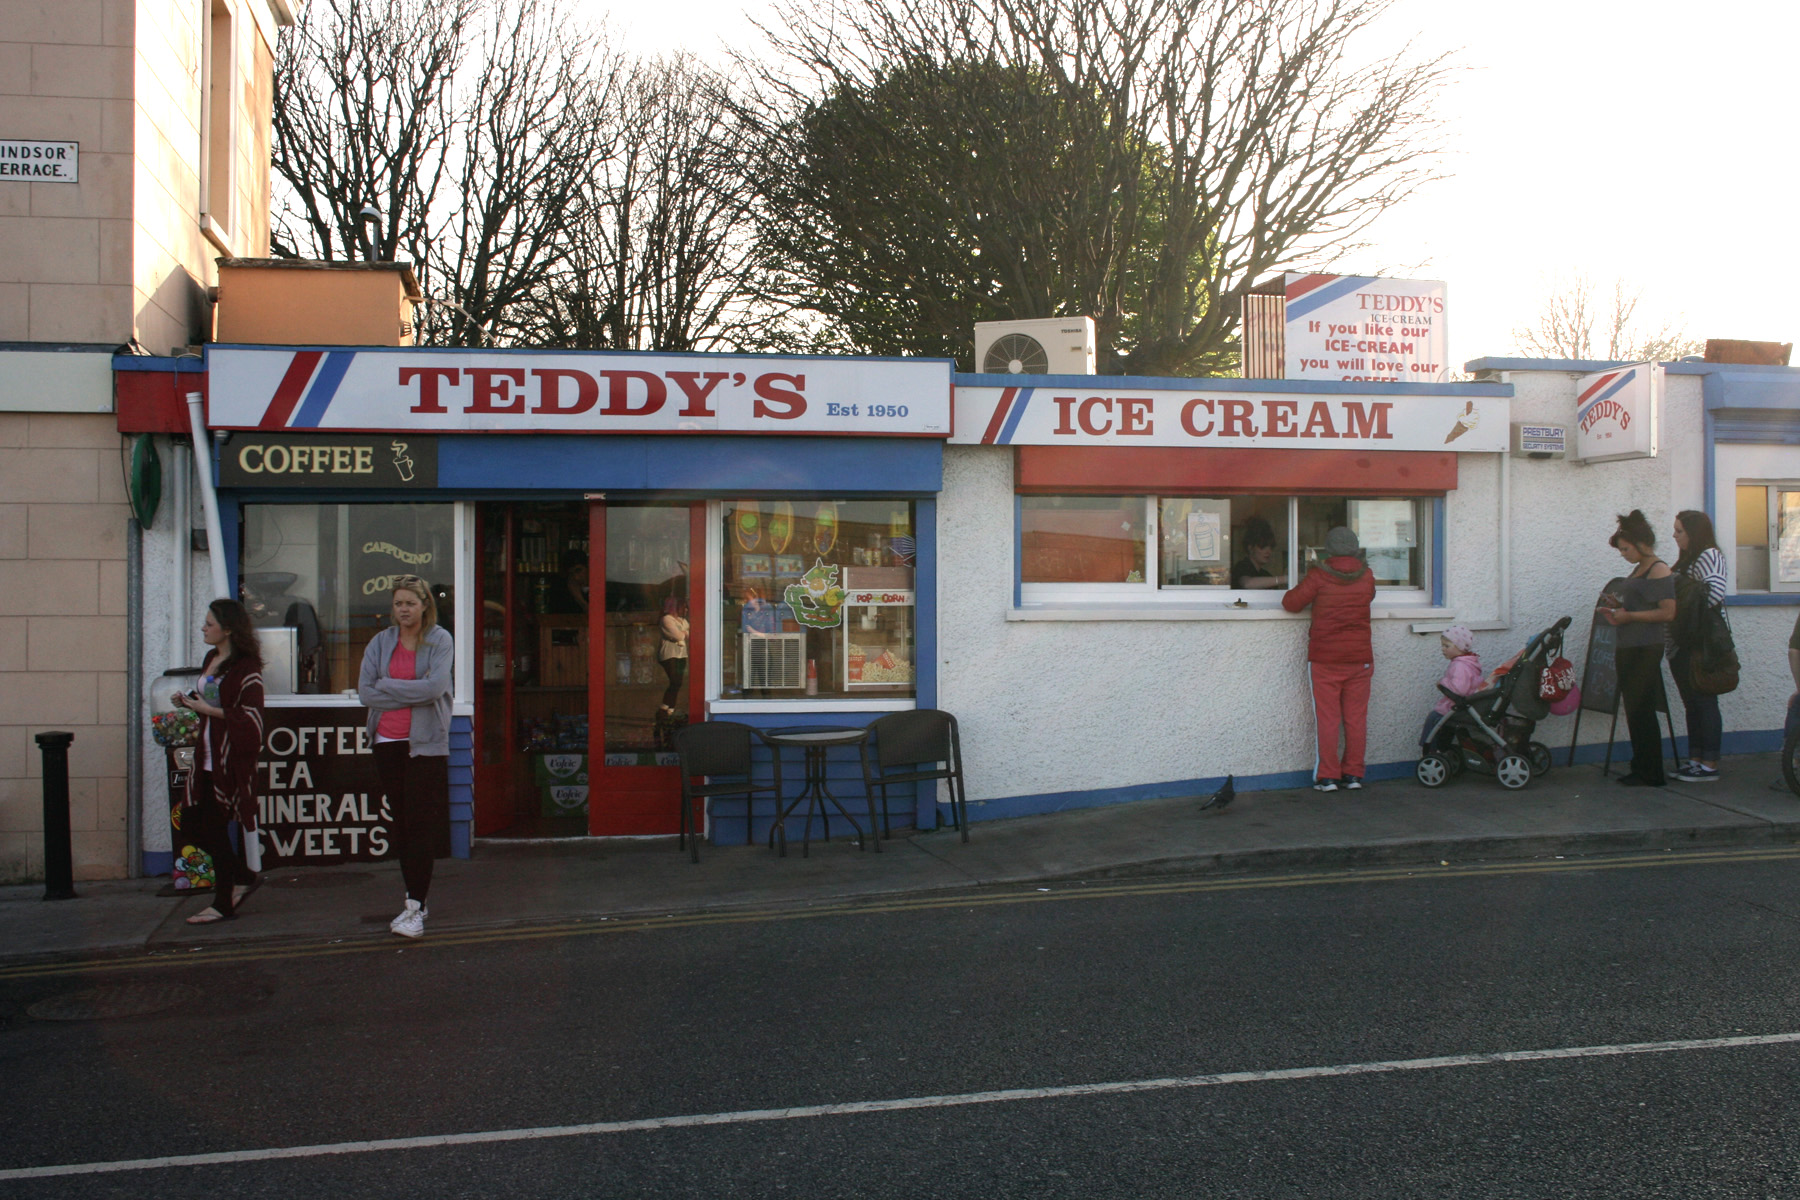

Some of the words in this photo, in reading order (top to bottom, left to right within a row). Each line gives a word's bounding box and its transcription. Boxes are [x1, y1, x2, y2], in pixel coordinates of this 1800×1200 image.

[0, 145, 66, 159] INDSOR
[0, 162, 67, 177] ERRACE.
[1356, 293, 1443, 314] TEDDY'S
[1371, 314, 1432, 325] ICE-CREAM
[1309, 320, 1321, 333] If
[1328, 323, 1357, 337] you
[1365, 323, 1393, 336] like
[1401, 326, 1429, 337] our
[1325, 339, 1413, 355] ICE-CREAM
[1300, 358, 1328, 373] you
[1337, 359, 1364, 371] will
[1372, 359, 1403, 372] love
[1411, 362, 1439, 373] our
[399, 366, 807, 420] TEDDY'S
[826, 402, 859, 417] Est
[867, 404, 909, 418] 1950
[1053, 396, 1153, 436] ICE
[1180, 398, 1393, 439] CREAM
[1580, 399, 1631, 435] TEDDY'S
[1522, 427, 1564, 437] PRESTBURY
[239, 444, 374, 475] COFFEE
[856, 593, 873, 603] POP
[881, 593, 905, 603] CORN
[260, 726, 373, 756] OFFEE
